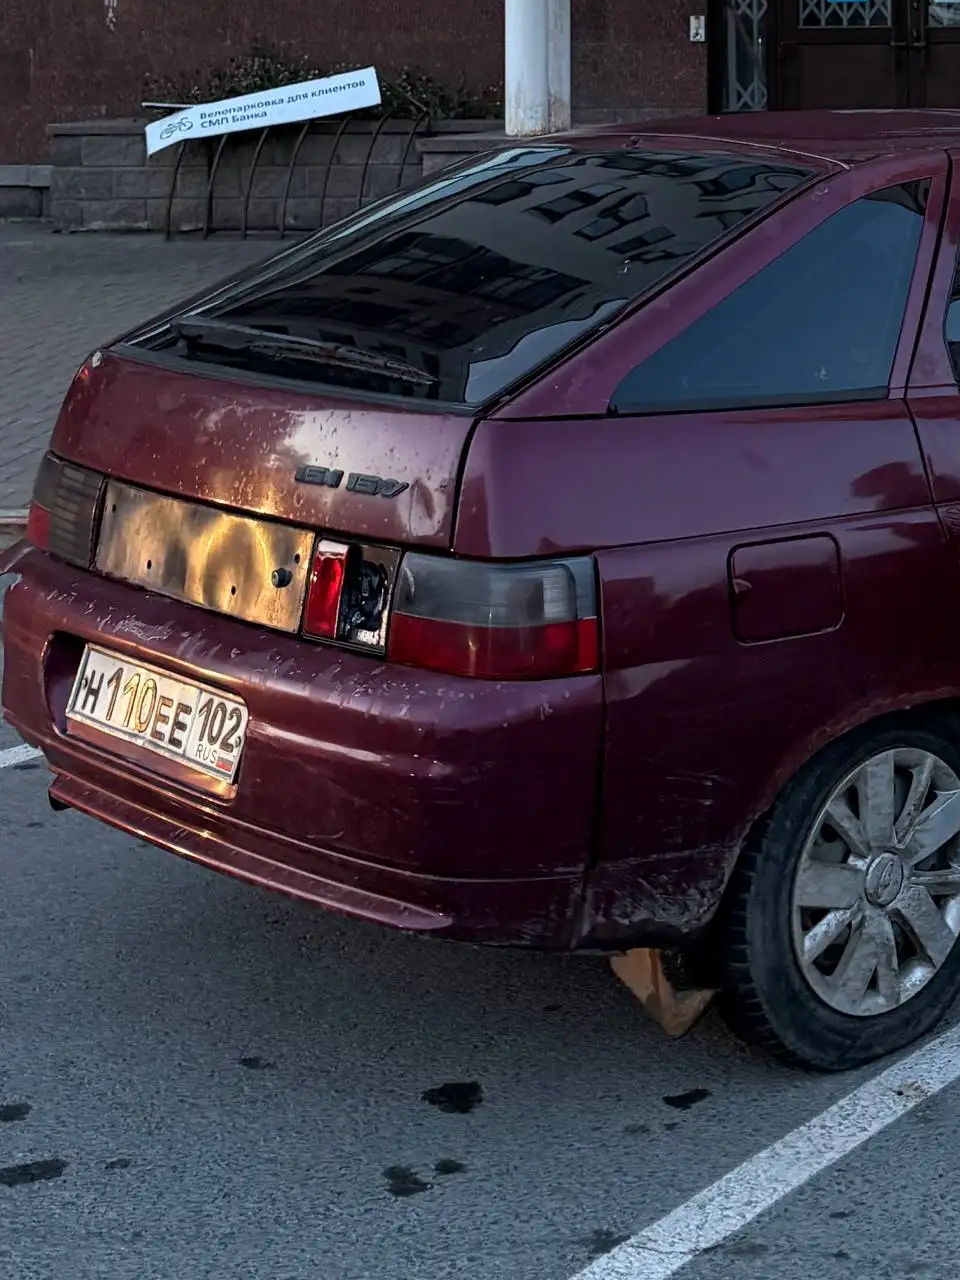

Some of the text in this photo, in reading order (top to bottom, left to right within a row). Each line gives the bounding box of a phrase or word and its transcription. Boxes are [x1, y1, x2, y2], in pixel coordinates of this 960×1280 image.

[200, 80, 366, 120] Велопарковка для клиентов
[200, 111, 267, 129] СМП Банка
[195, 743, 218, 764] RUS
